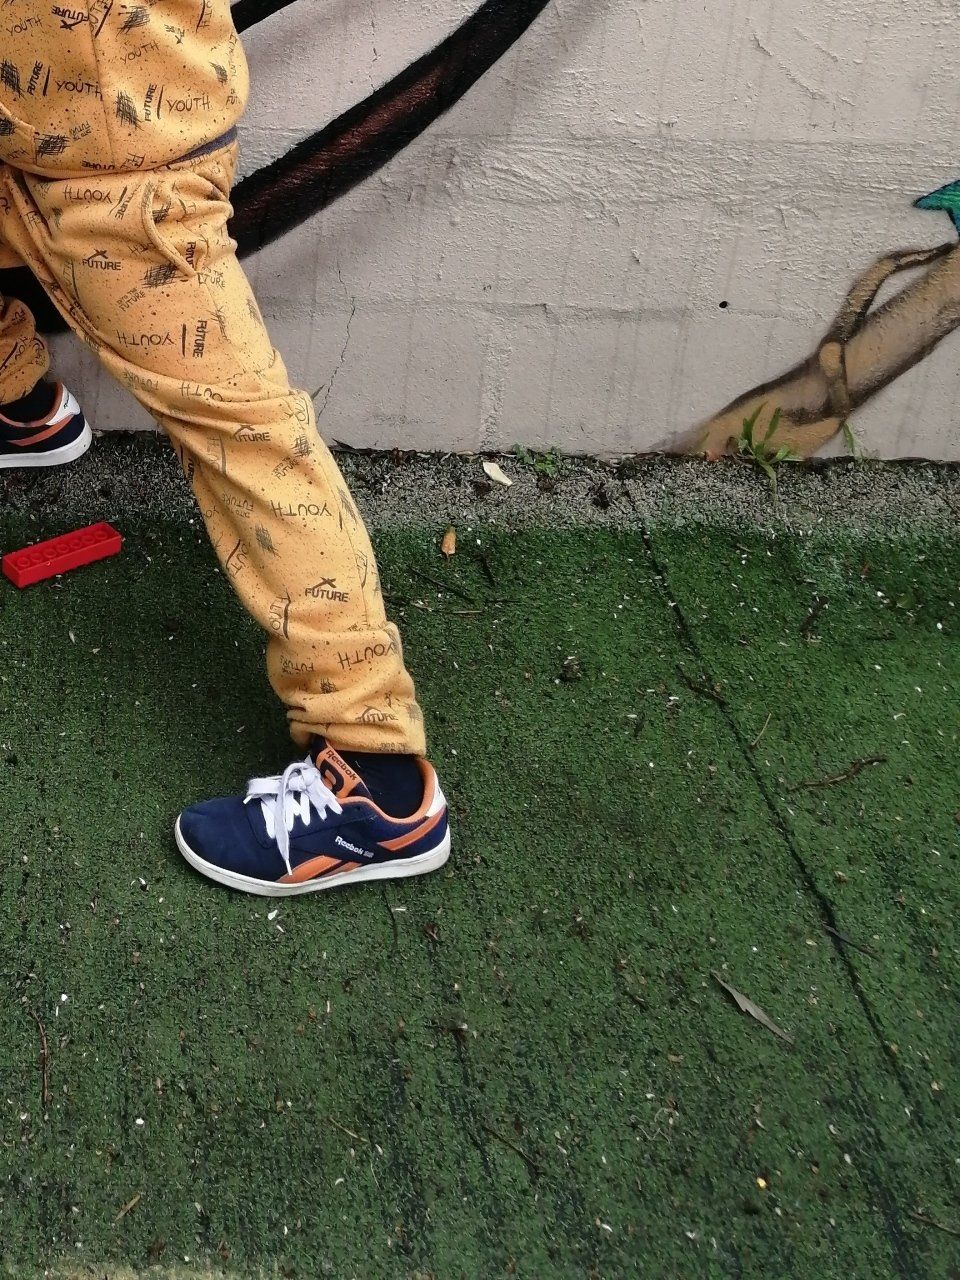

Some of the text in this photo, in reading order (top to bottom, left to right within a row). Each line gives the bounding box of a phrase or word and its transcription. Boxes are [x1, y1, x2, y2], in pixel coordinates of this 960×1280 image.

[51, 5, 90, 22] FUTURE
[6, 14, 44, 37] YOUTH
[120, 40, 160, 65] YOUTH
[26, 60, 44, 96] FUTURE
[55, 80, 104, 101] YOUTH
[144, 83, 158, 122] FUTURE
[165, 95, 210, 114] YOUTH
[63, 184, 113, 204] YOUTH
[82, 259, 122, 271] FUTURE
[119, 290, 146, 312] FUTURE
[116, 330, 175, 347] YOUTH
[193, 320, 208, 359] FUTURE
[179, 382, 224, 402] OUTH
[235, 431, 271, 443] UTURE
[270, 499, 332, 518] YOUTH
[304, 587, 350, 603] FUTURE
[269, 593, 290, 637] OUTH
[337, 641, 394, 670] YOUTH
[326, 749, 358, 781] Reebok
[334, 835, 365, 856] Reebok
